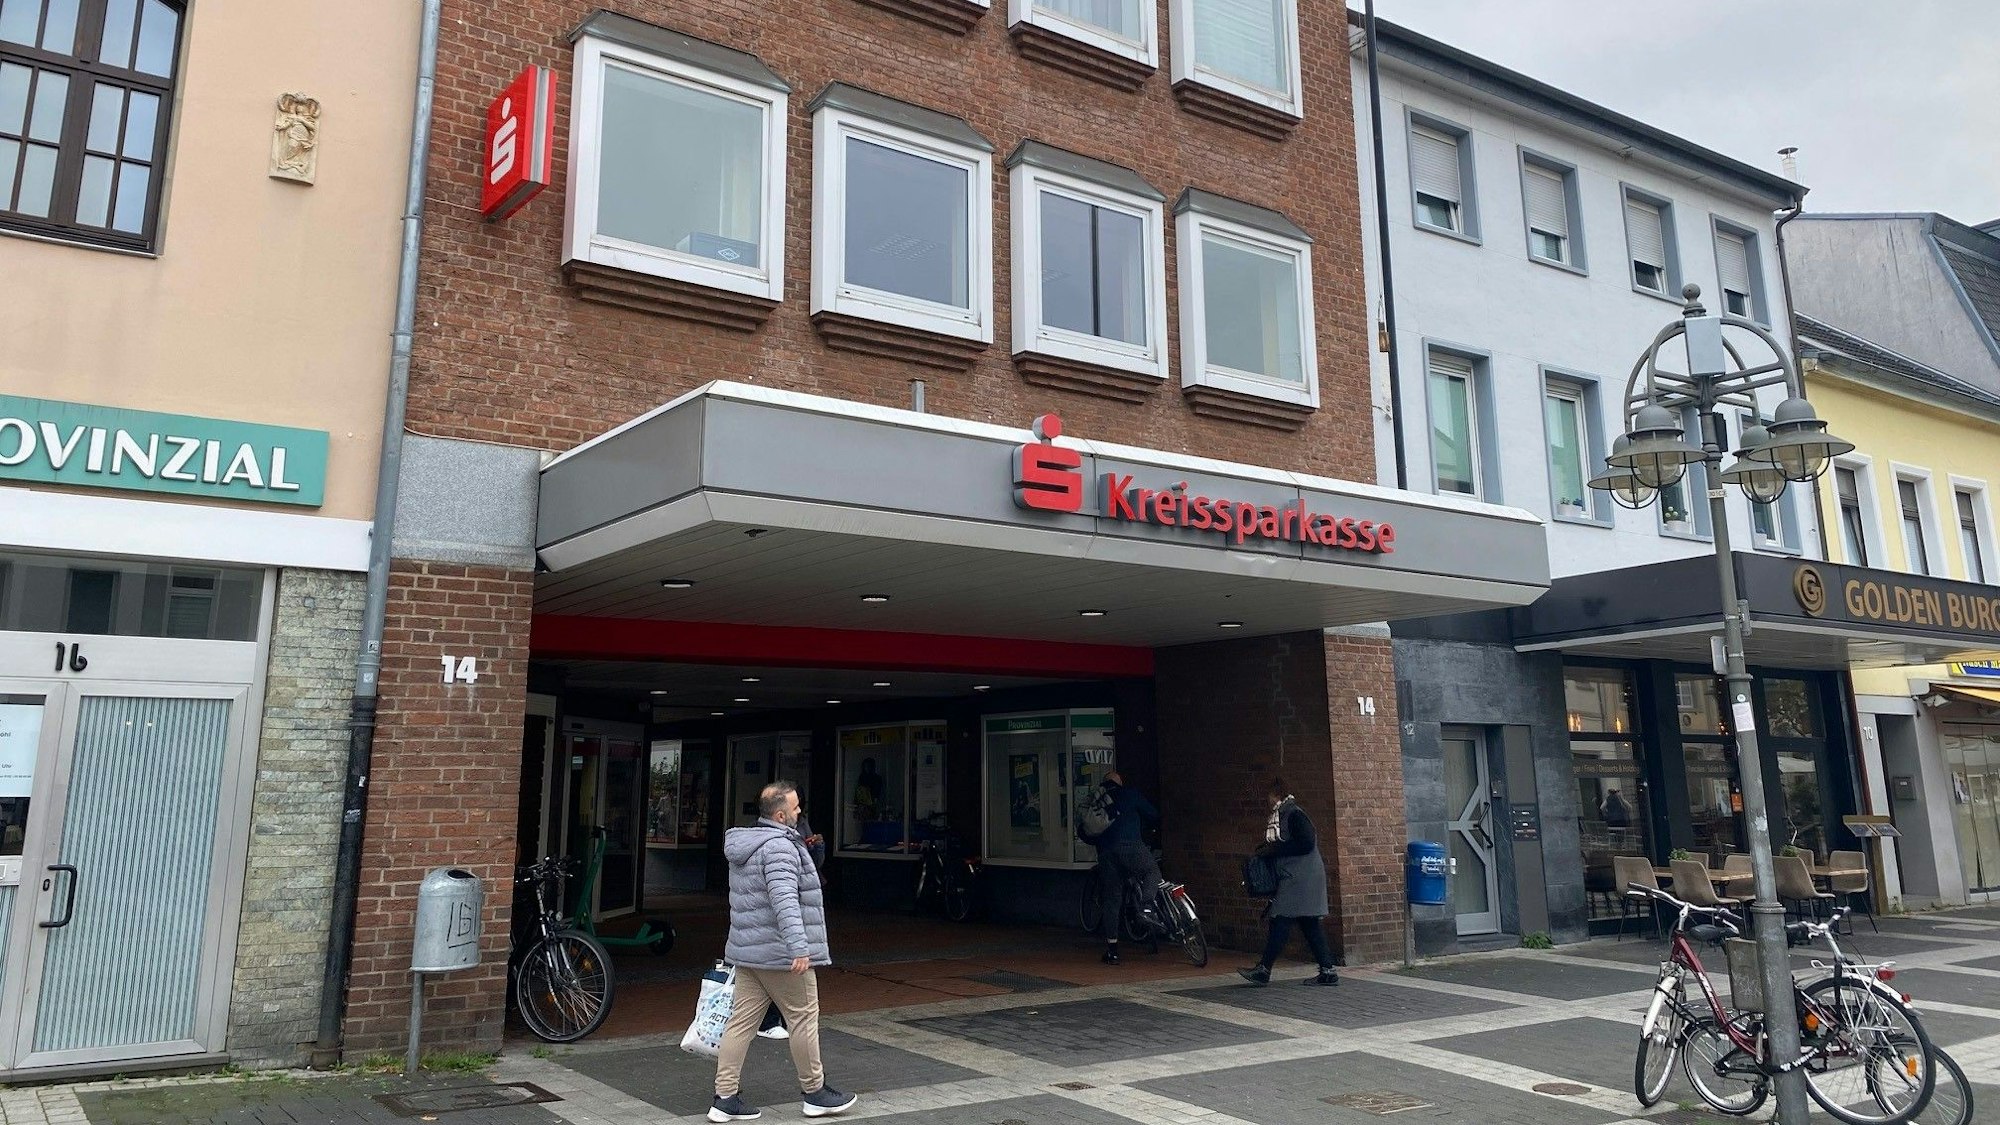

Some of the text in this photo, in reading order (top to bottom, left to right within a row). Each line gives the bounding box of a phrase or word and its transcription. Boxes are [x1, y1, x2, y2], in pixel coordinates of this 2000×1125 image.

[1100, 473, 1396, 554] Kreissparkasse
[1845, 579, 1943, 626] GOLDEN
[55, 641, 88, 672] 16
[441, 655, 478, 684] 14
[1357, 696, 1376, 716] 14
[1404, 723, 1415, 735] 12
[1862, 726, 1874, 740] 10
